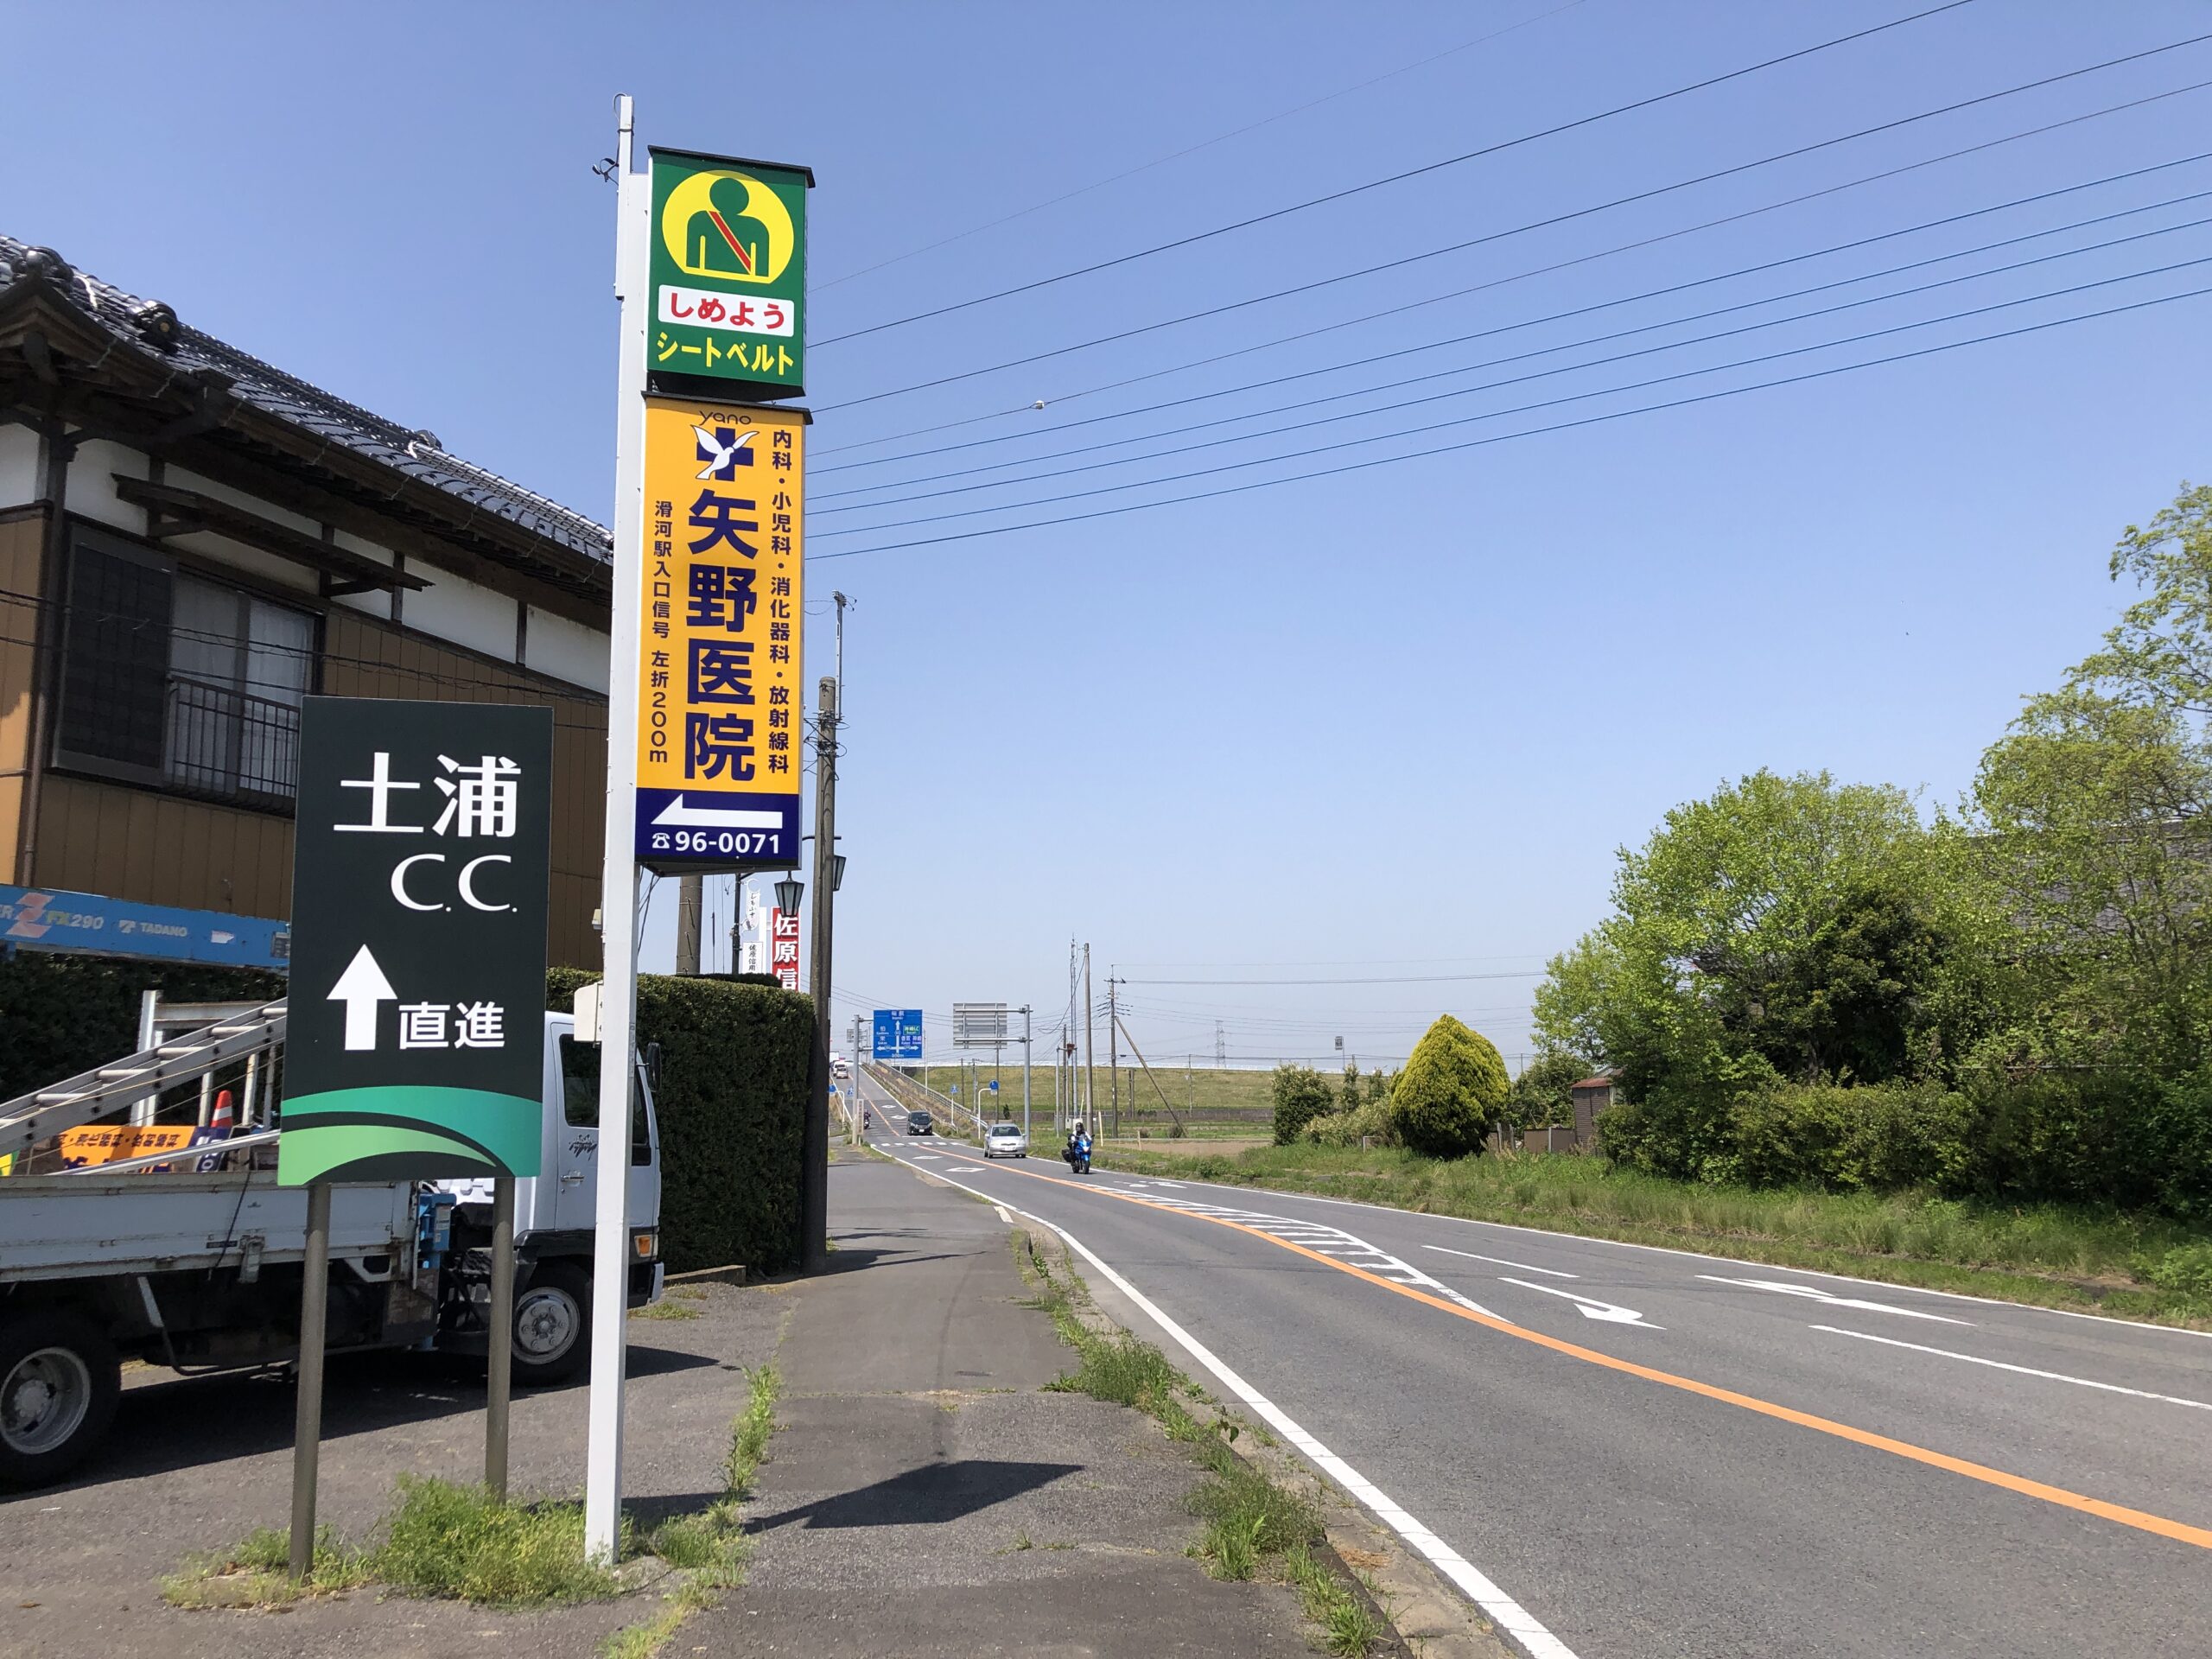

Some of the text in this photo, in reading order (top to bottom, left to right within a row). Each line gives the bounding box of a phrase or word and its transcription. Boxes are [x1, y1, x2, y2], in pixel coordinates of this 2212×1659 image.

[671, 291, 785, 330] しめよう
[656, 331, 794, 376] シートベルト
[698, 410, 752, 426] yano
[652, 500, 673, 639] 滑河駅入口信号
[768, 429, 792, 774] 内科・小児科・消化器科・放射線科
[684, 488, 760, 782] 矢野医院
[333, 751, 522, 838] 土浦
[390, 852, 518, 912] C.C.
[397, 1000, 505, 1051] 直進
